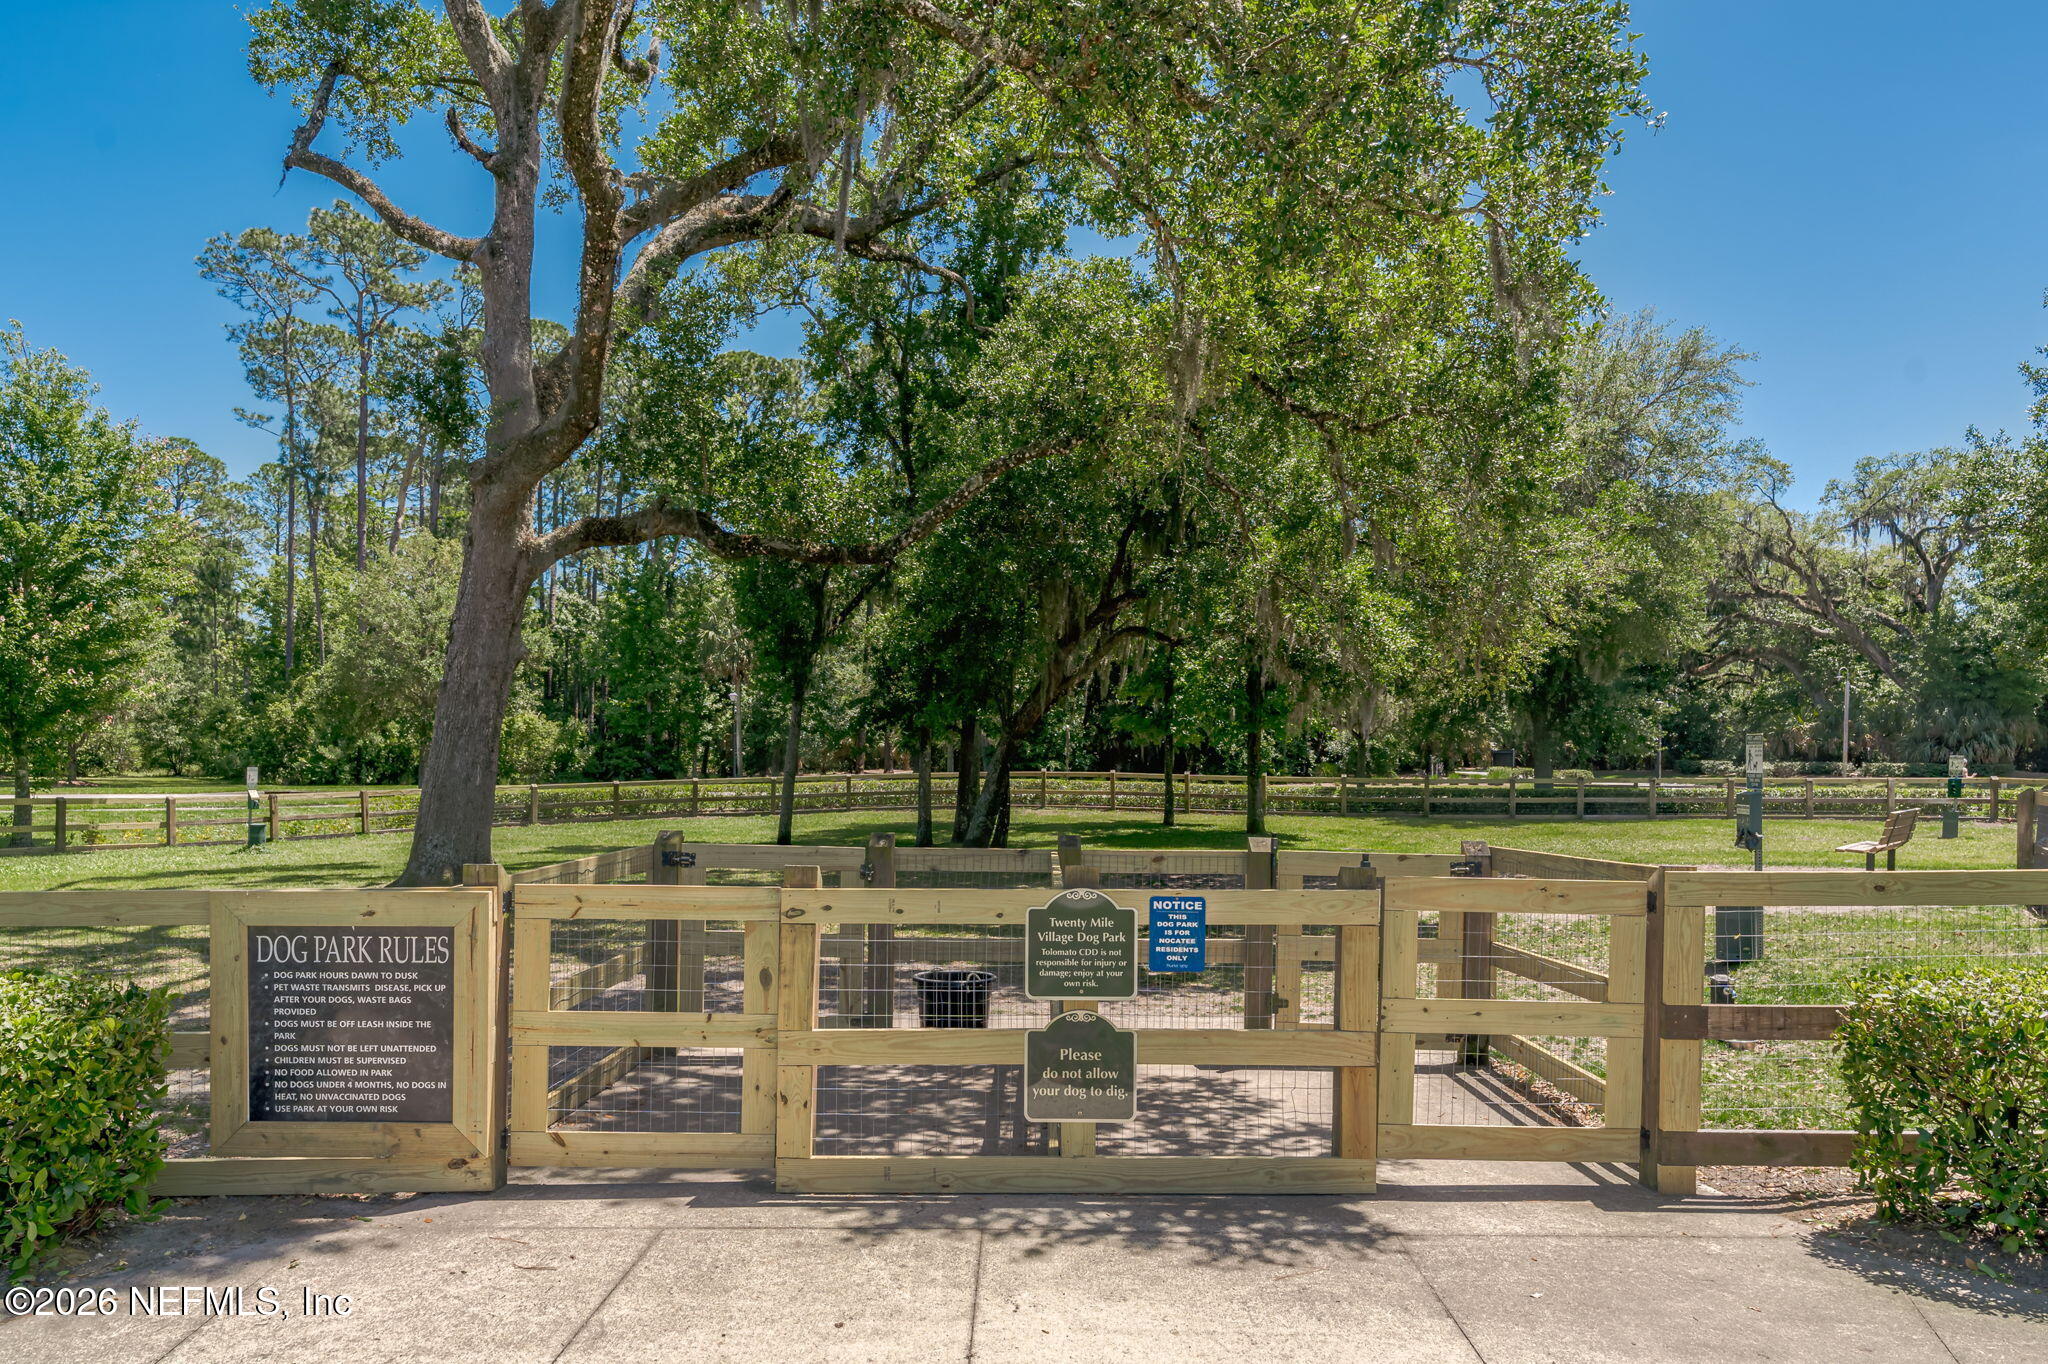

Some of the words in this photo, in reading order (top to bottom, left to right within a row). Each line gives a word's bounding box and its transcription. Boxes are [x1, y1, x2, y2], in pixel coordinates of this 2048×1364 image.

[1153, 901, 1203, 910] NOTICE
[1049, 917, 1087, 930] Twenty
[1090, 918, 1114, 928] Mile
[1038, 932, 1074, 945] Village
[1077, 932, 1100, 945] Dog
[1103, 933, 1126, 942] Park
[256, 935, 308, 964] DOG
[313, 935, 373, 964] PARK
[378, 935, 449, 964] RULES
[1041, 948, 1077, 956] Tolomato
[1079, 948, 1099, 956] CDD
[1100, 948, 1106, 956] is
[1036, 958, 1079, 968] responsible
[1081, 958, 1092, 966] for
[1094, 958, 1117, 969] injury
[1039, 969, 1071, 979] damage;
[1073, 969, 1094, 979] enjoy
[1106, 971, 1123, 979] your
[1082, 979, 1099, 987] risk.
[274, 984, 289, 992] PET
[290, 984, 320, 992] WASTE
[322, 984, 370, 992] TRANSMITS
[375, 984, 412, 993] DISEASE,
[414, 984, 432, 992] PICK
[434, 984, 446, 992] UP
[274, 996, 300, 1004] AFTER
[302, 996, 326, 1004] YOUR
[328, 996, 355, 1004] DOGS,
[357, 996, 386, 1004] WASTE
[389, 996, 412, 1004] BAGS
[274, 1008, 317, 1016] PROVIDED
[274, 1020, 299, 1028] DOGS
[300, 1020, 325, 1028] MUST
[327, 1020, 337, 1028] BE
[339, 1020, 355, 1028] OFF
[357, 1020, 384, 1028] LEASH
[386, 1020, 413, 1028] INSIDE
[416, 1020, 432, 1028] THE
[274, 1032, 296, 1040] PARK
[1060, 1048, 1102, 1061] Please
[274, 1069, 288, 1077] NO
[290, 1069, 314, 1077] FOOD
[316, 1069, 358, 1077] ALLOWED
[360, 1069, 368, 1077] IN
[371, 1069, 392, 1077] PARK
[1043, 1068, 1059, 1080] do
[1062, 1070, 1082, 1080] not
[1086, 1068, 1119, 1080] allow
[274, 1081, 288, 1089] NO
[290, 1081, 314, 1089] DOGS
[316, 1081, 346, 1089] UNDER
[347, 1081, 353, 1089] 4
[354, 1081, 394, 1090] MONTHS,
[396, 1081, 409, 1089] NO
[411, 1081, 435, 1089] DOGS
[438, 1081, 447, 1089] IN
[1032, 1087, 1060, 1100] your
[1064, 1085, 1086, 1099] dog
[1090, 1086, 1103, 1097] to
[1106, 1085, 1128, 1099] dig.
[275, 1093, 298, 1102] HEAT,
[300, 1093, 313, 1101] NO
[315, 1093, 379, 1101] UNVACCINATED
[382, 1093, 406, 1101] DOGS
[275, 1105, 290, 1113] USE
[293, 1105, 314, 1113] PARK
[317, 1105, 327, 1113] AT
[329, 1105, 353, 1113] YOUR
[356, 1105, 377, 1113] OWN
[379, 1105, 398, 1113] RISK
